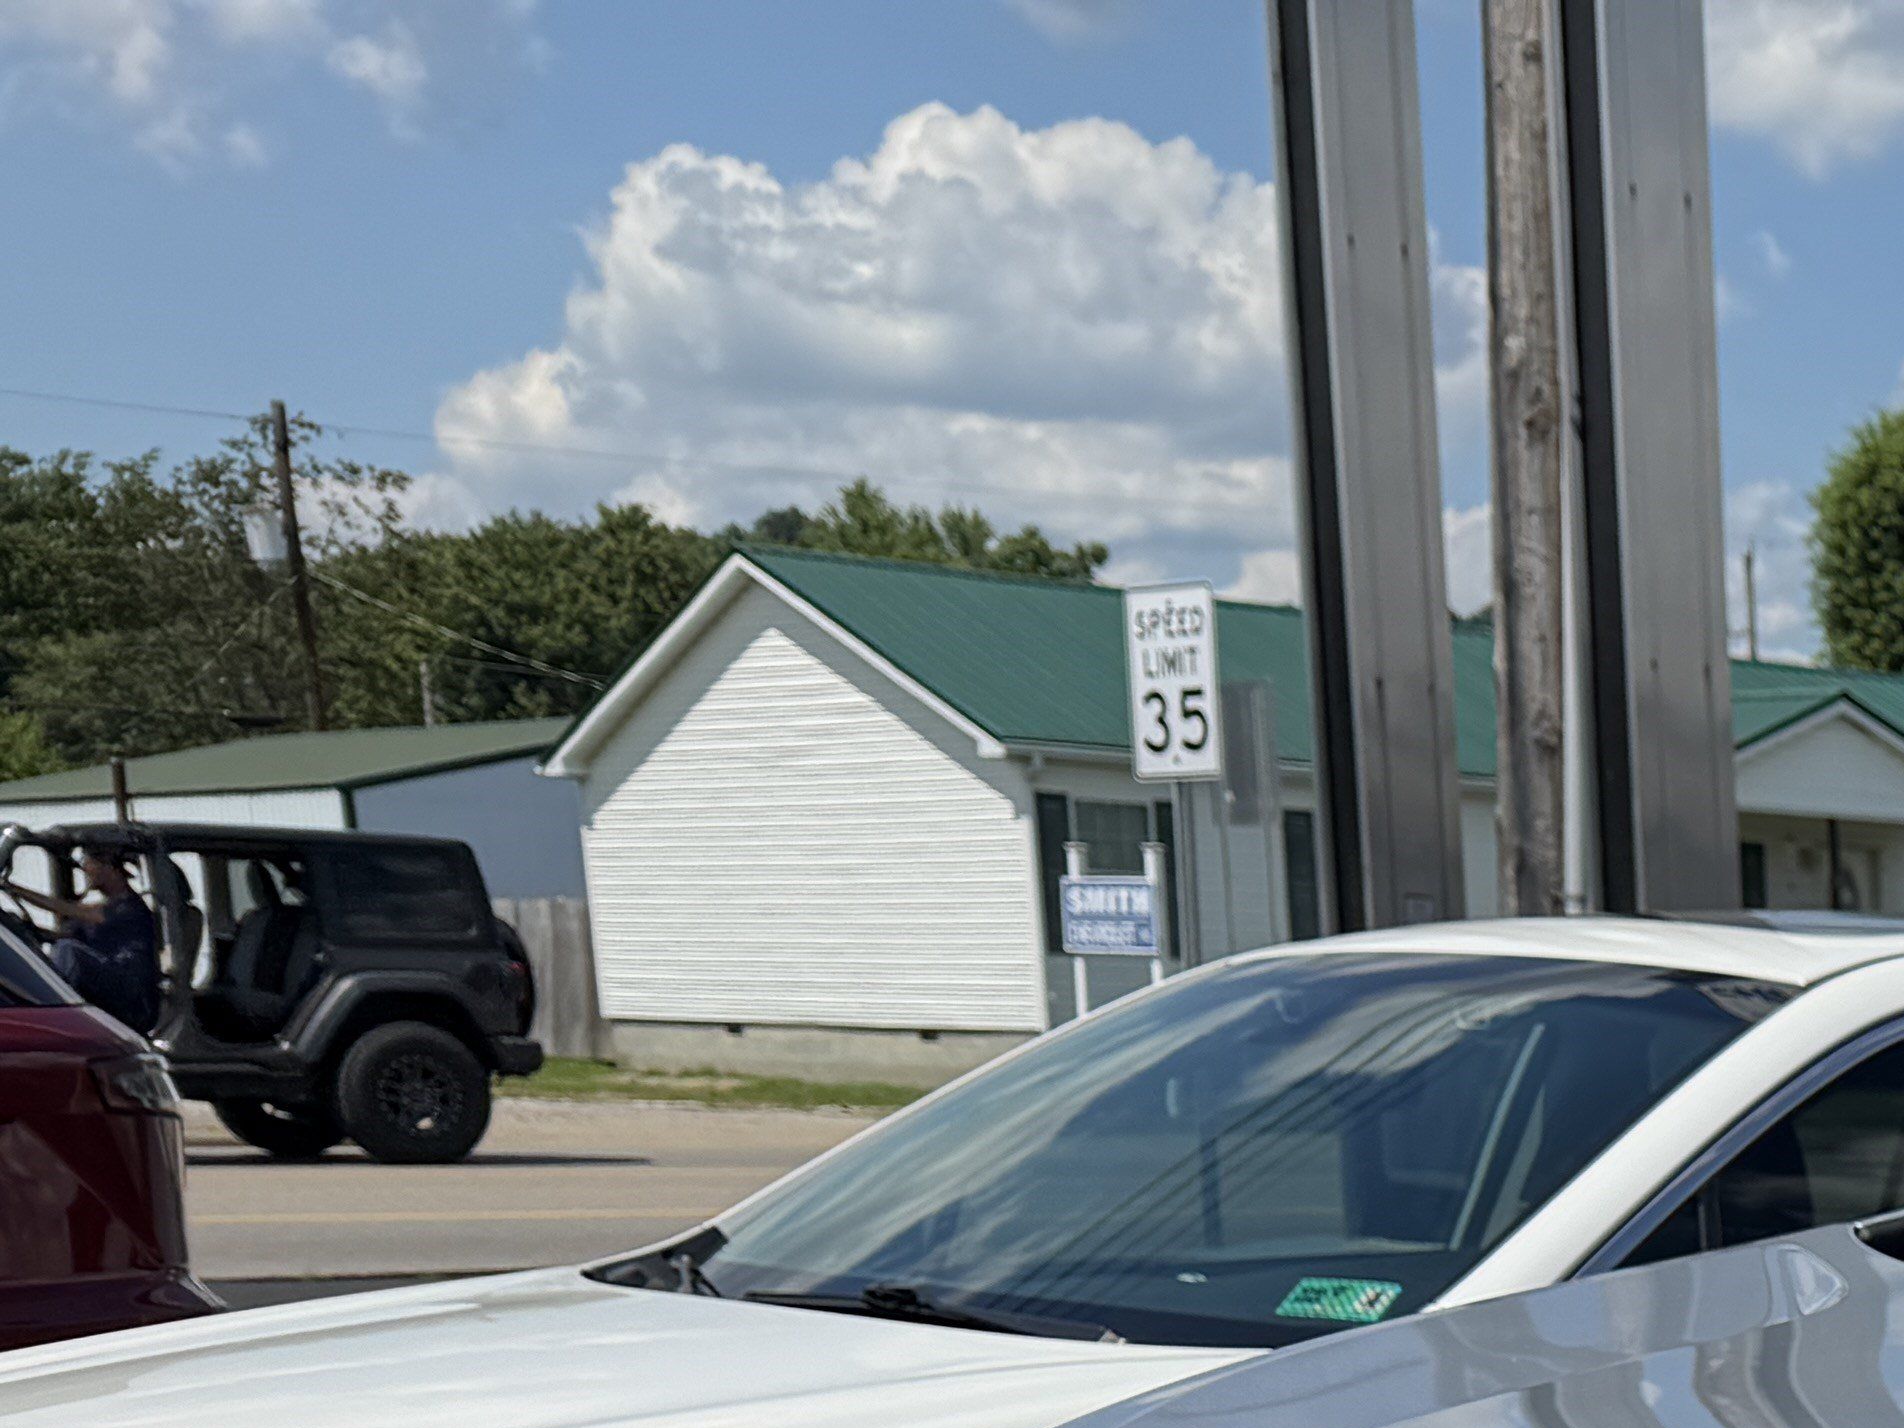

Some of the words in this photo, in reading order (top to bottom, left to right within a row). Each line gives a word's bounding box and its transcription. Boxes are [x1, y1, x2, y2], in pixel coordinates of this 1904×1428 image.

[1134, 604, 1205, 640] SPEED
[1141, 646, 1201, 679] LIMIT
[1143, 687, 1208, 753] 35
[1065, 886, 1149, 915] SMITH
